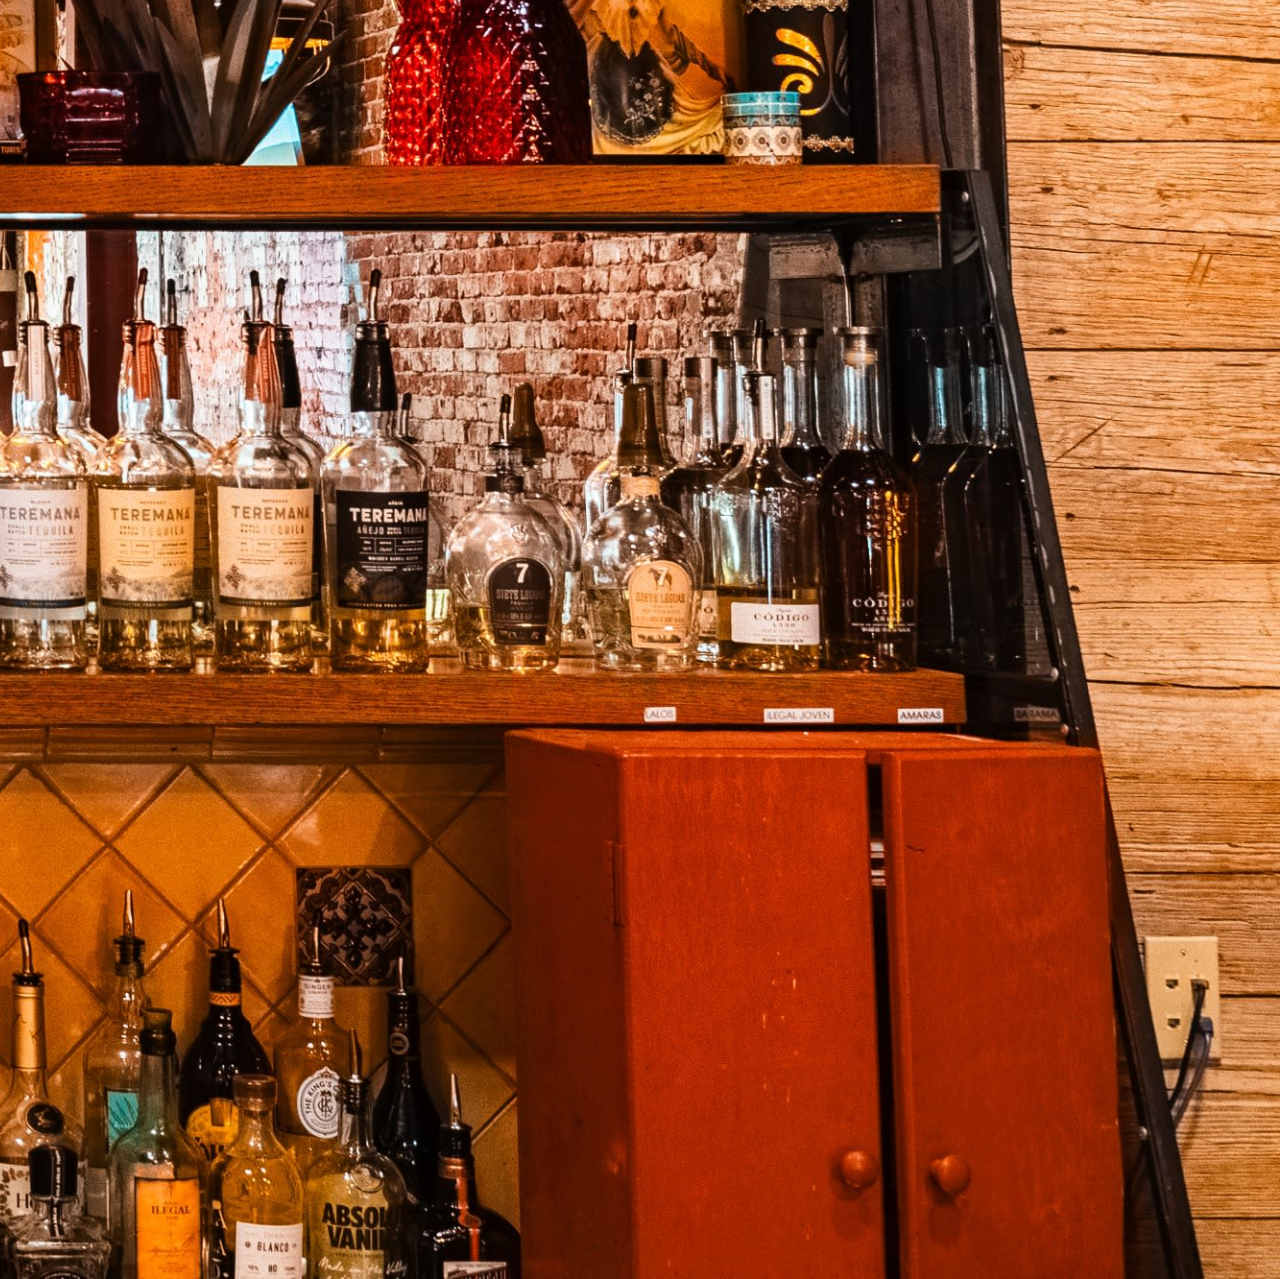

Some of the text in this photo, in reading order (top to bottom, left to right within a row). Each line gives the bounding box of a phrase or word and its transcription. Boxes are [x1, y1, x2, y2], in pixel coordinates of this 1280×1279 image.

[0, 506, 81, 521] TEREMANA
[110, 506, 191, 522] TEREMANA
[231, 505, 310, 519] TEREMANA
[515, 563, 529, 584] 7
[657, 567, 669, 586] 7
[799, 709, 831, 721] JOVEN
[899, 709, 942, 721] AMARAS
[305, 1079, 333, 1115] THE KING'S
[151, 1205, 191, 1215] ILEGAL
[256, 1241, 290, 1253] BLANCO
